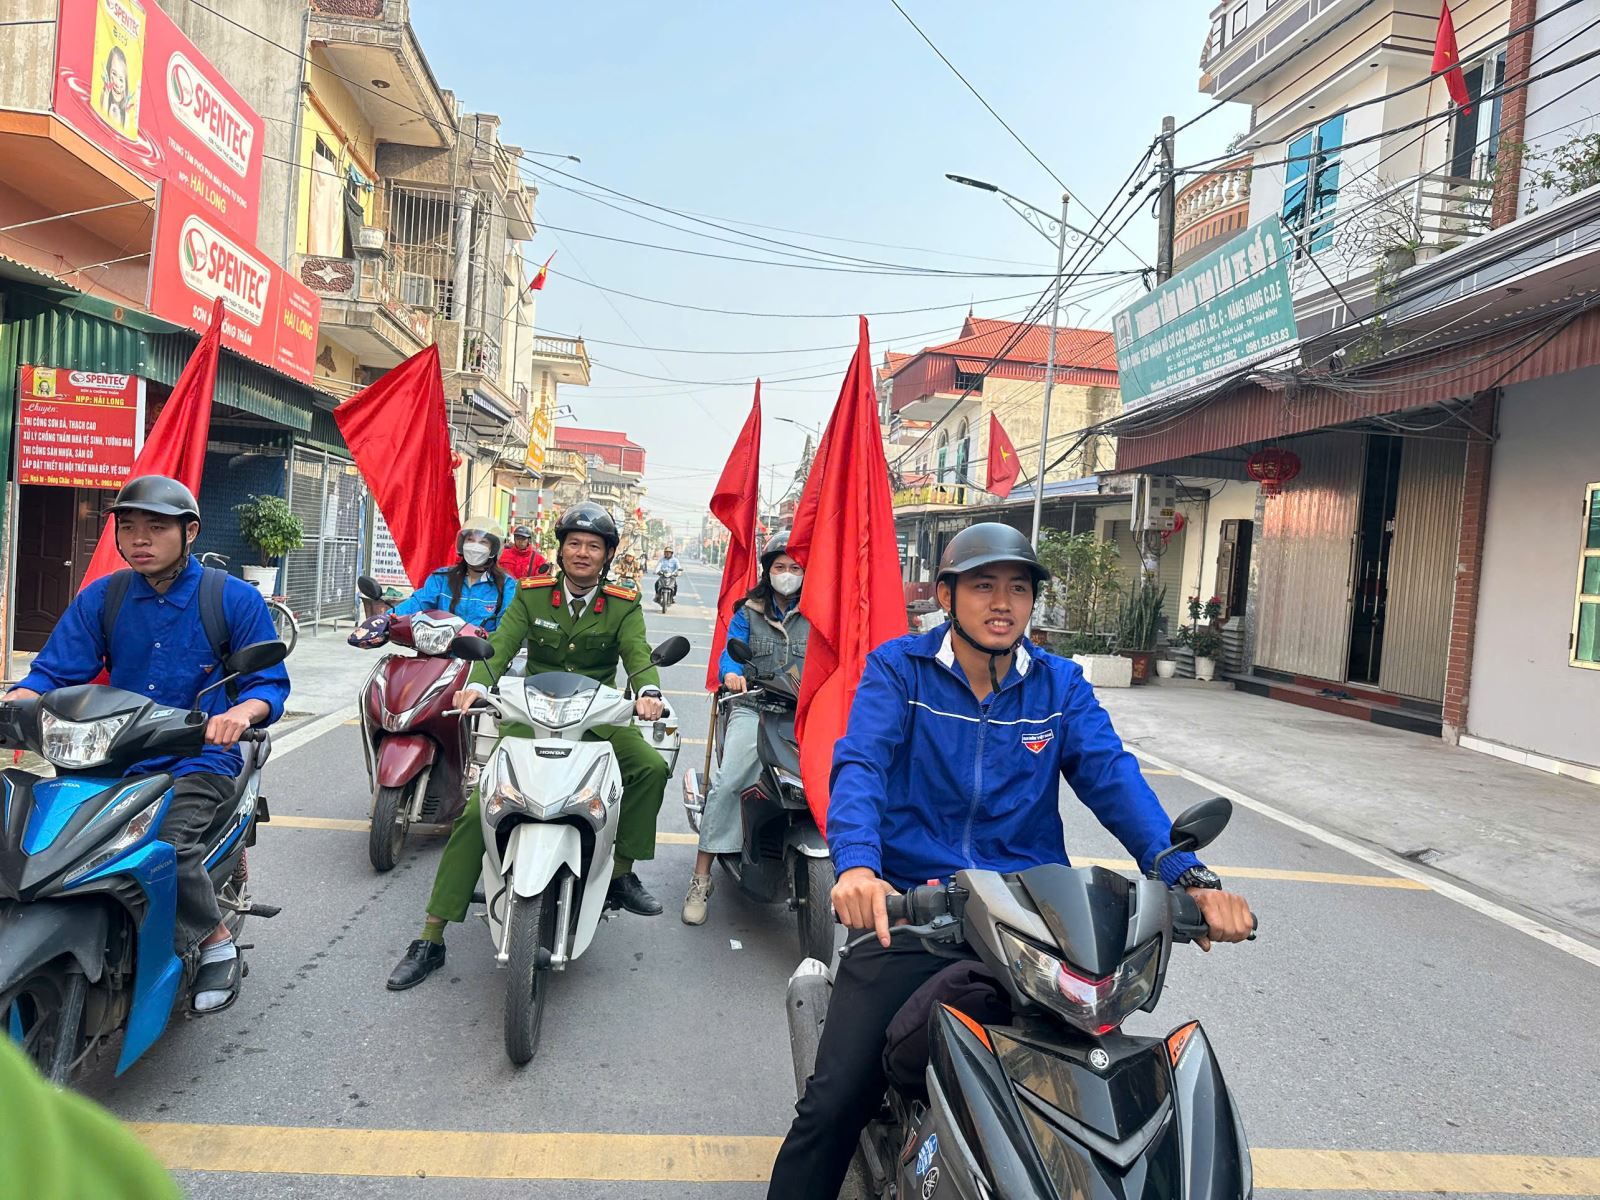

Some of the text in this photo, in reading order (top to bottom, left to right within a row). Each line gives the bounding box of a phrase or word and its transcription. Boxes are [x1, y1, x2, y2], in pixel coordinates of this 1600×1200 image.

[194, 82, 248, 161] SPENTEC
[190, 173, 204, 198] HẢI
[205, 185, 226, 214] LONG
[1214, 254, 1234, 297] LÁI
[1231, 248, 1250, 288] XE
[1248, 226, 1266, 278] SỐ
[1265, 234, 1277, 269] 3
[208, 241, 265, 309] SPENTEC
[192, 304, 207, 323] SƠN
[1219, 310, 1224, 325] C
[283, 308, 313, 341] HẢI LONG
[85, 374, 124, 385] SPENTEC
[24, 402, 58, 415] Chuyên:
[75, 395, 124, 405] NPP: HẢI LONG
[24, 416, 32, 425] THI
[32, 416, 47, 426] CÔNG
[47, 418, 58, 427] SƠN
[69, 420, 85, 431] THẠCH
[86, 421, 96, 430] CAO
[38, 430, 55, 441] CHỐNG
[82, 433, 89, 446] VỆ
[122, 436, 132, 447] MÁI
[23, 445, 31, 454] THI
[31, 444, 46, 455] CÔNG
[22, 456, 32, 468] LẮP
[44, 458, 58, 470] THIẾT
[74, 460, 87, 472] THẤT
[87, 462, 98, 473] NHÀ
[110, 463, 117, 476] VỆ
[150, 860, 173, 875] HONDA
